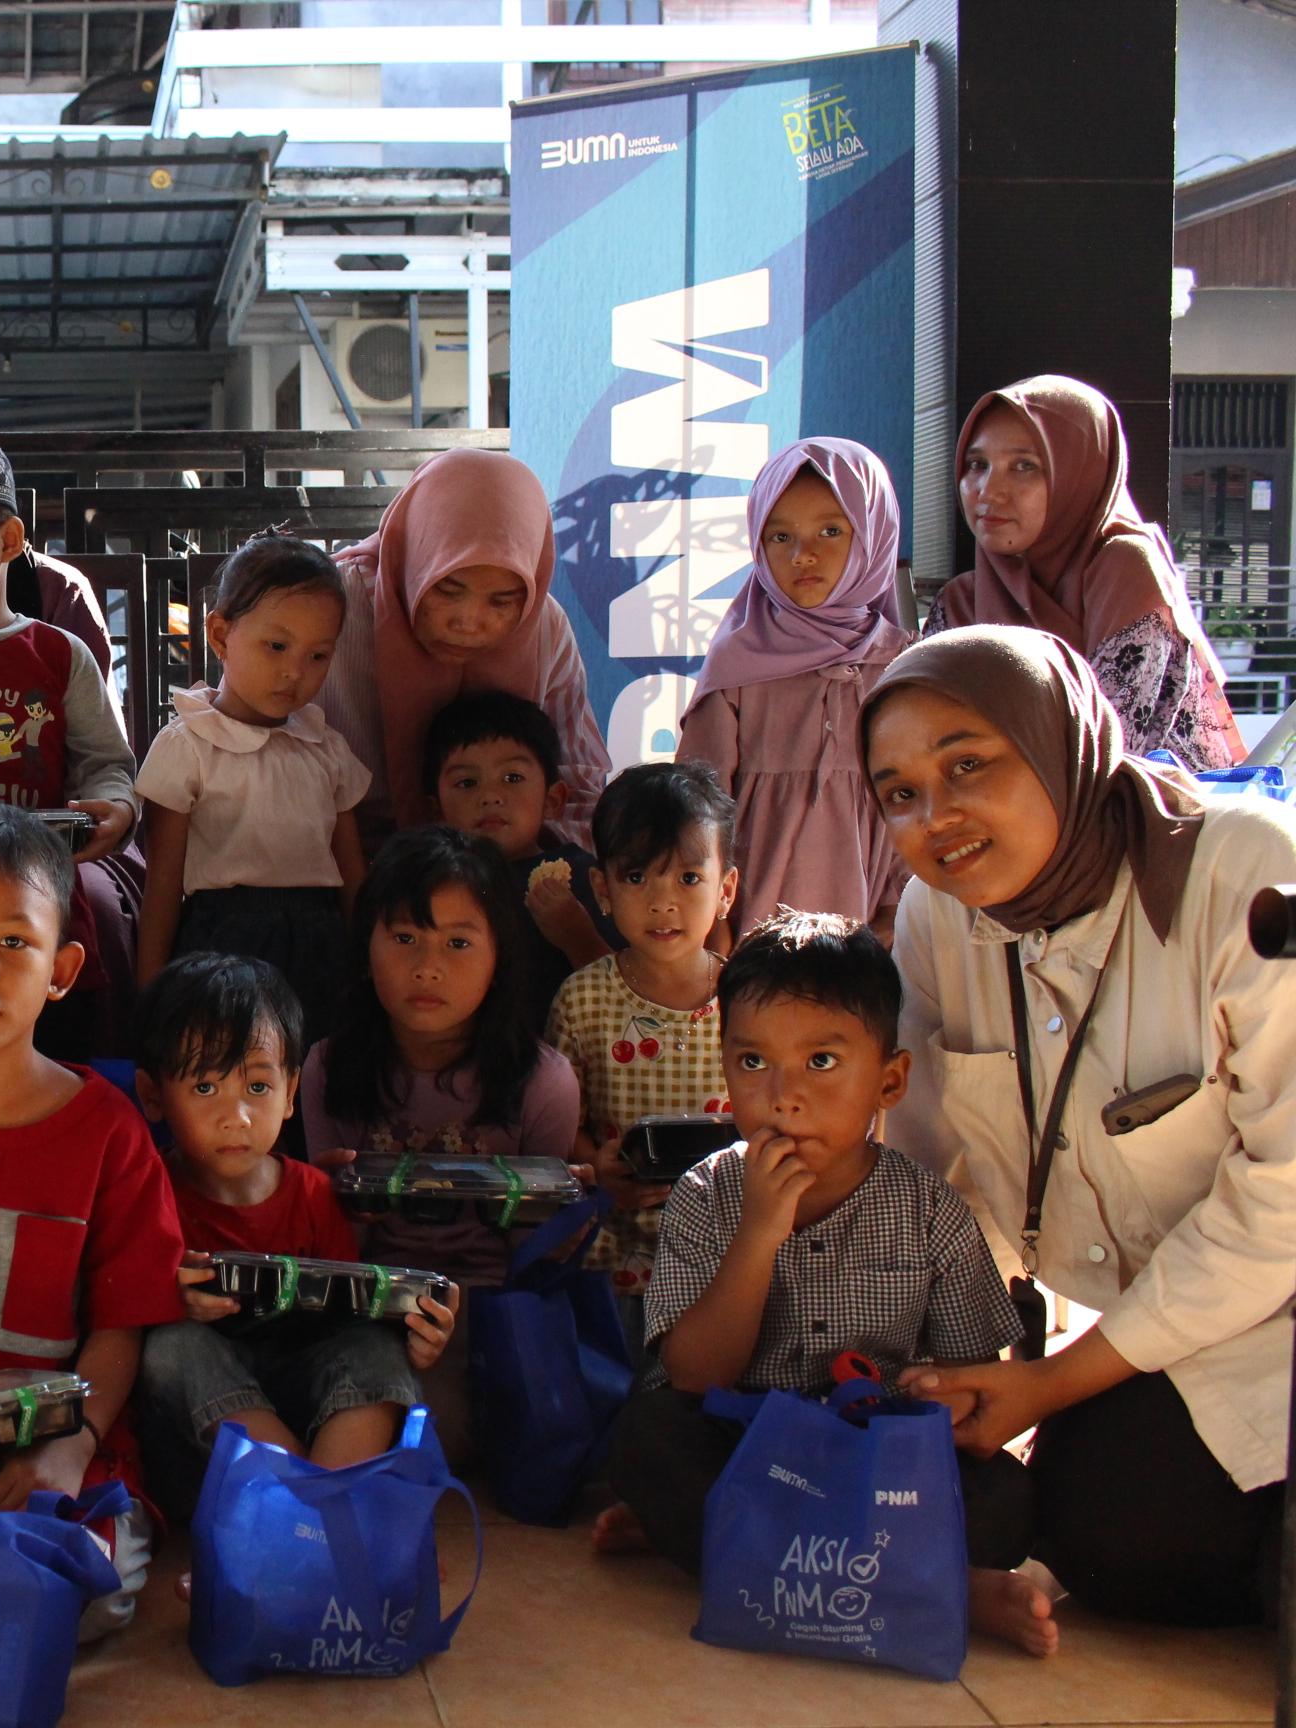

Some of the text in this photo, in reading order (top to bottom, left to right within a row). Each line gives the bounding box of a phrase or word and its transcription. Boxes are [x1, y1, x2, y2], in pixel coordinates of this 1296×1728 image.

[782, 96, 857, 155] BETA
[541, 132, 660, 169] BUMN UNTUK
[628, 142, 678, 158] INDONESIA
[795, 145, 834, 173] SELALU
[837, 136, 865, 159] ADA
[875, 1490, 918, 1506] PNM
[780, 1534, 849, 1576] AKSI
[773, 1576, 825, 1619] PNM
[308, 1637, 362, 1669] PNM
